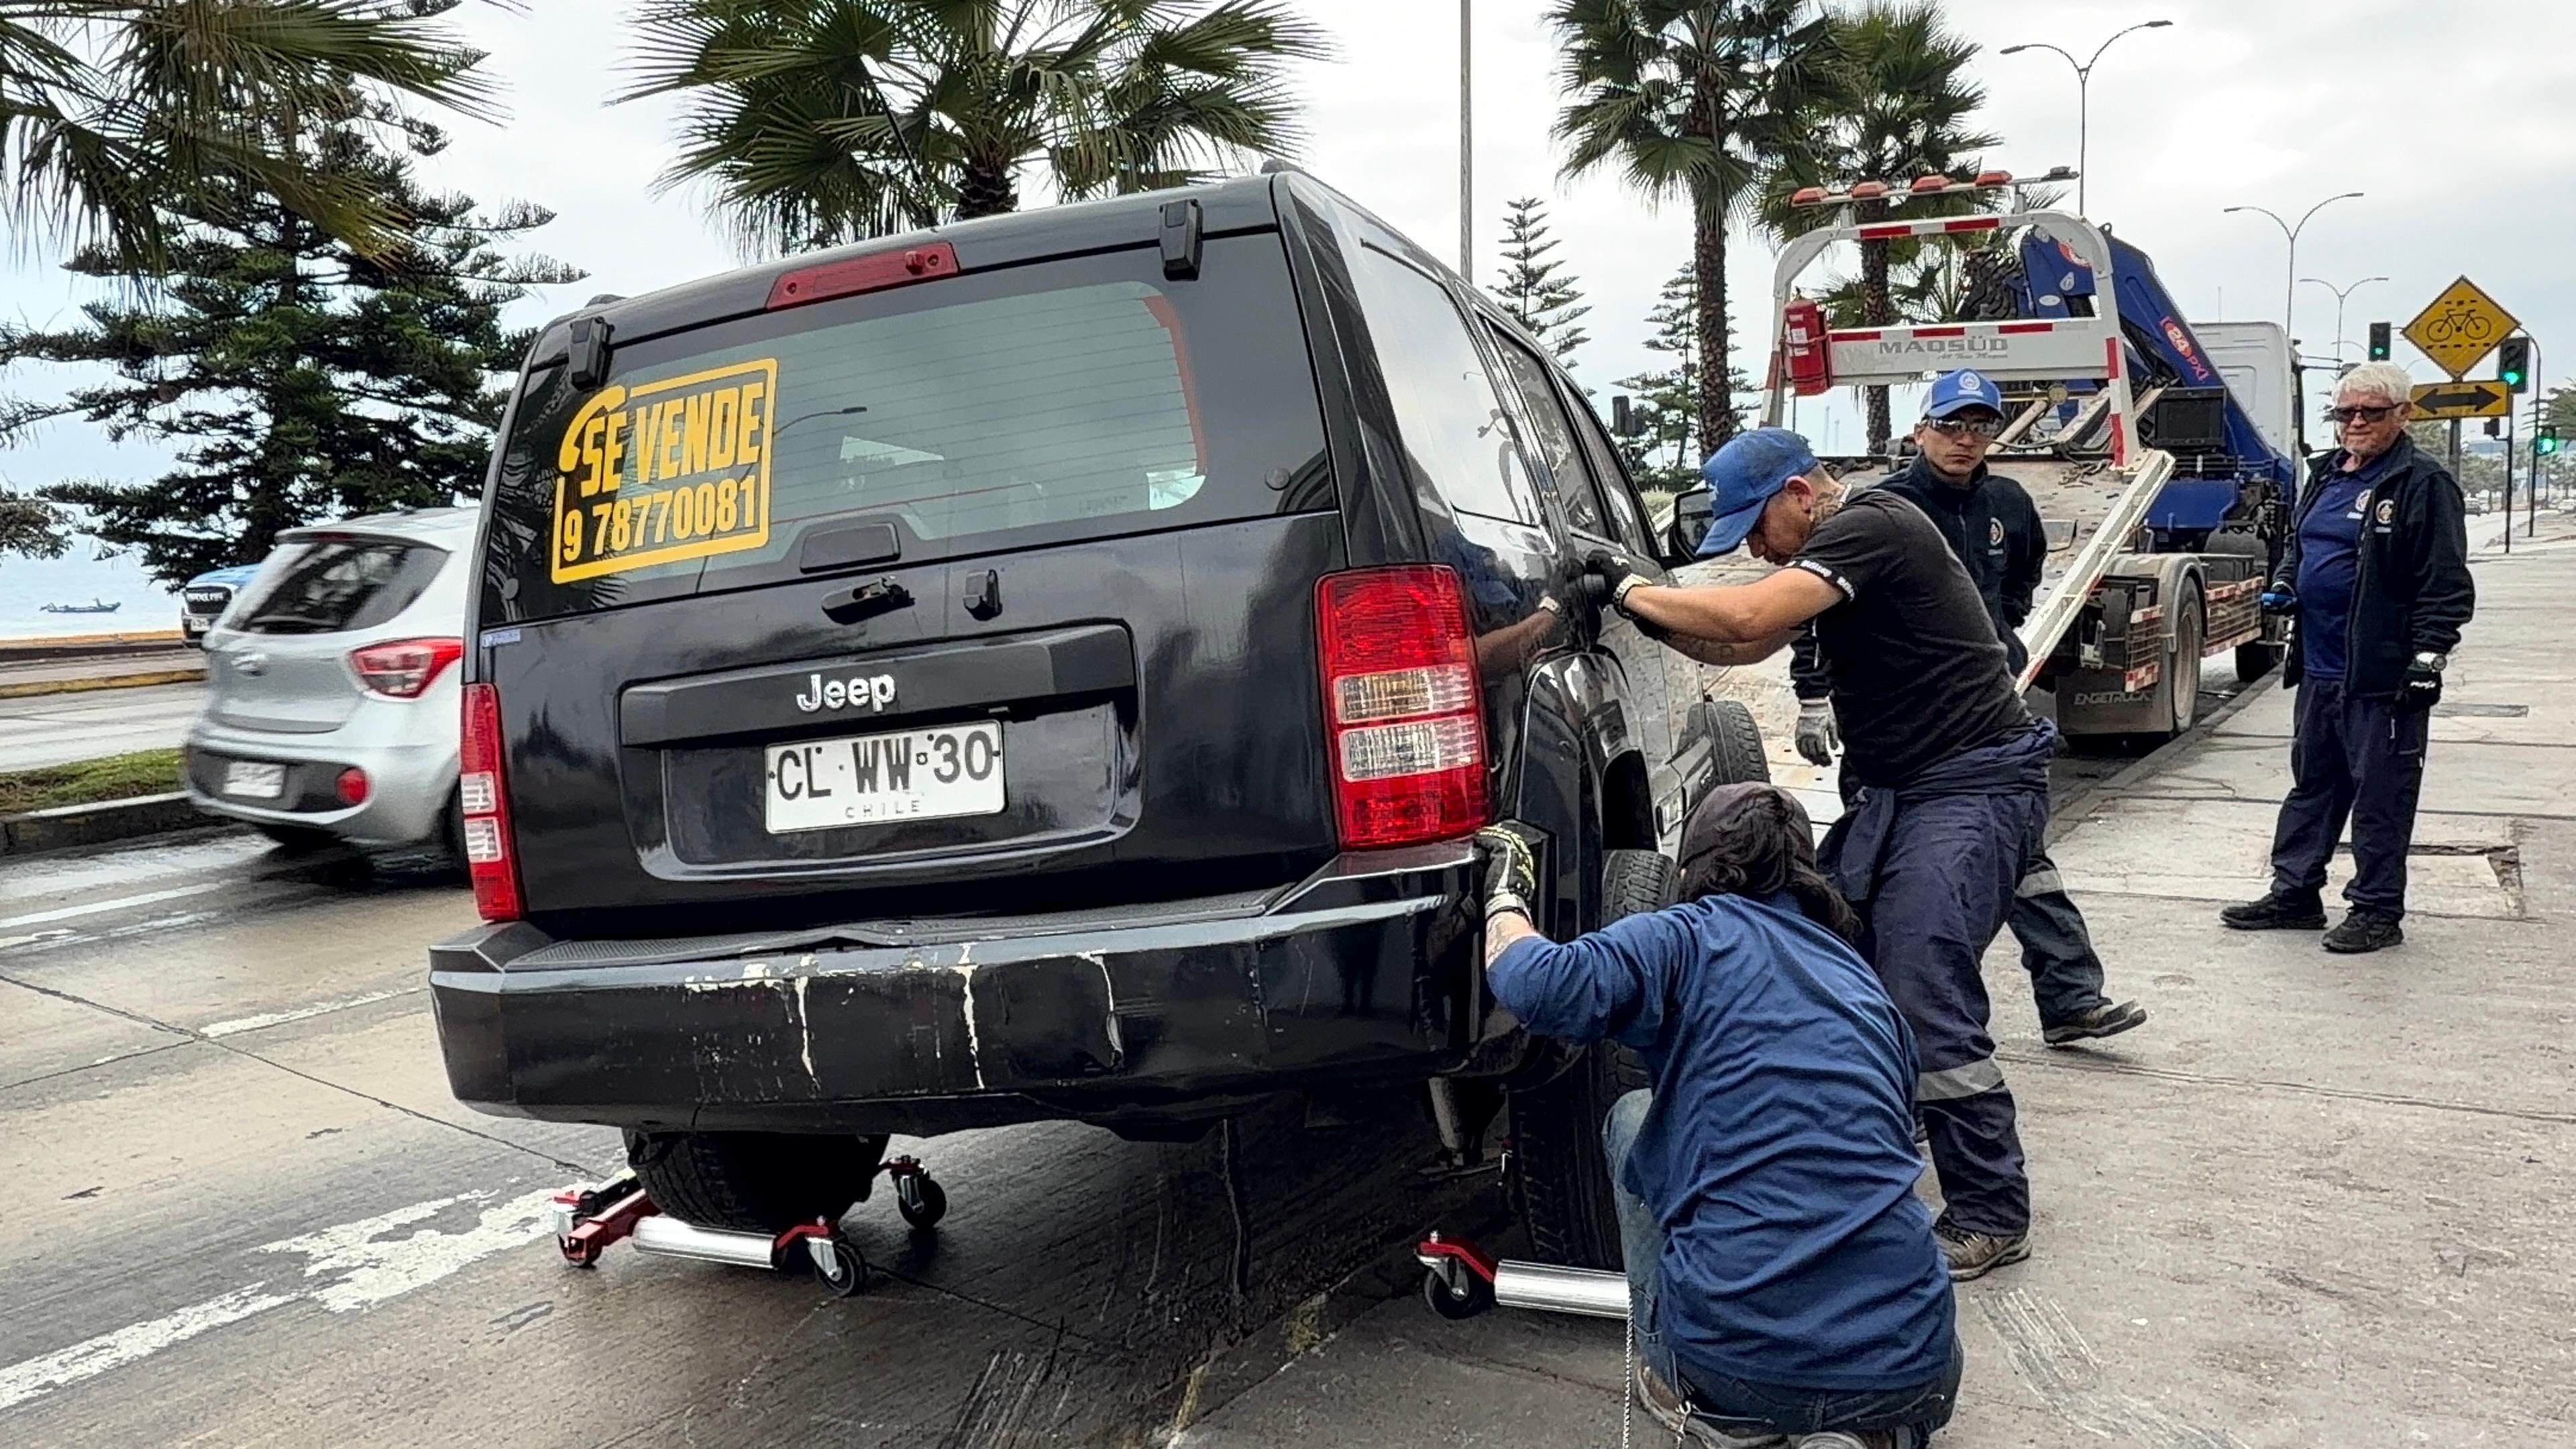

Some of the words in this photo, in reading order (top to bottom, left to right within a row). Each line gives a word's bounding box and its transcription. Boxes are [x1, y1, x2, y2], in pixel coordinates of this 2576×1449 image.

[1879, 335, 2008, 354] MAQSÜD
[581, 411, 627, 498] SE
[636, 383, 763, 484] VENDE
[563, 509, 583, 562] 9
[592, 476, 756, 556] 78770081
[796, 674, 896, 712] Jeep
[776, 747, 832, 801] CL
[852, 737, 912, 794] WW
[932, 730, 994, 784] 30
[845, 800, 921, 819] CHILE
